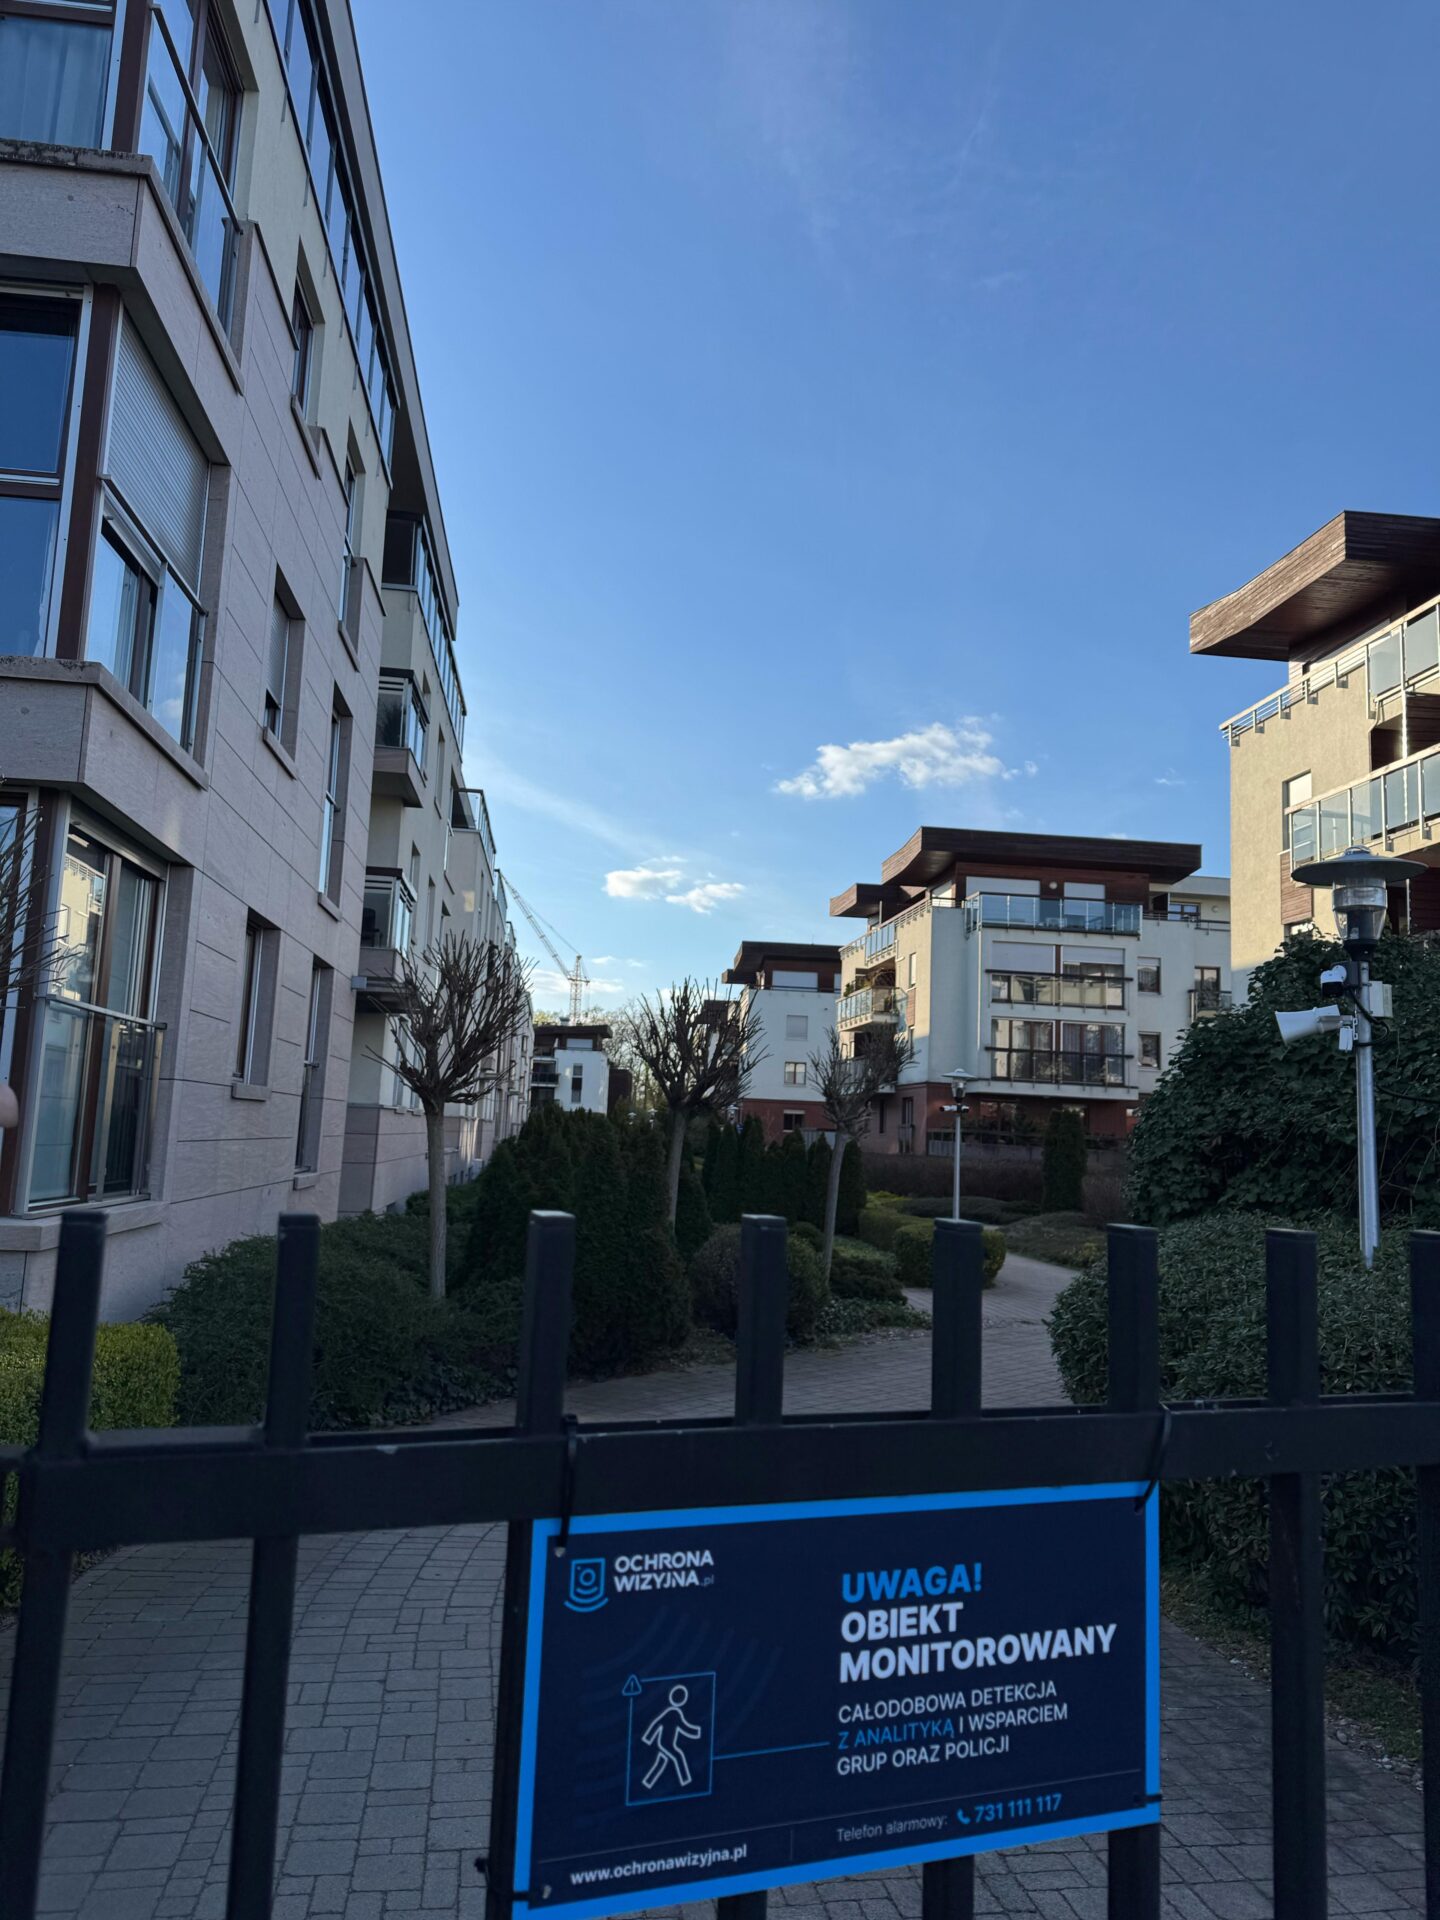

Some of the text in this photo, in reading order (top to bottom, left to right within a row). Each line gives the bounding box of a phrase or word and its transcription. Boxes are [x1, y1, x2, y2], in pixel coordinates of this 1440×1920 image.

[614, 1550, 714, 1573] OCHRONA
[842, 1563, 982, 1603] UWAGA!
[841, 1602, 963, 1643] OBIEKT
[840, 1624, 1117, 1683] MONITOROWANY
[838, 1680, 1057, 1723] CAŁODOBOWA DETEKCJA
[838, 1731, 849, 1750] Z
[854, 1719, 954, 1748] ANALITYKĄ
[968, 1703, 1068, 1732] WSPARCIEM
[837, 1735, 1010, 1775] GRUP ORAZ POLICJI
[836, 1793, 1062, 1842] Telefon alarmowy: 731 111 117
[570, 1844, 747, 1885] www.ochronawizyjna.pl
